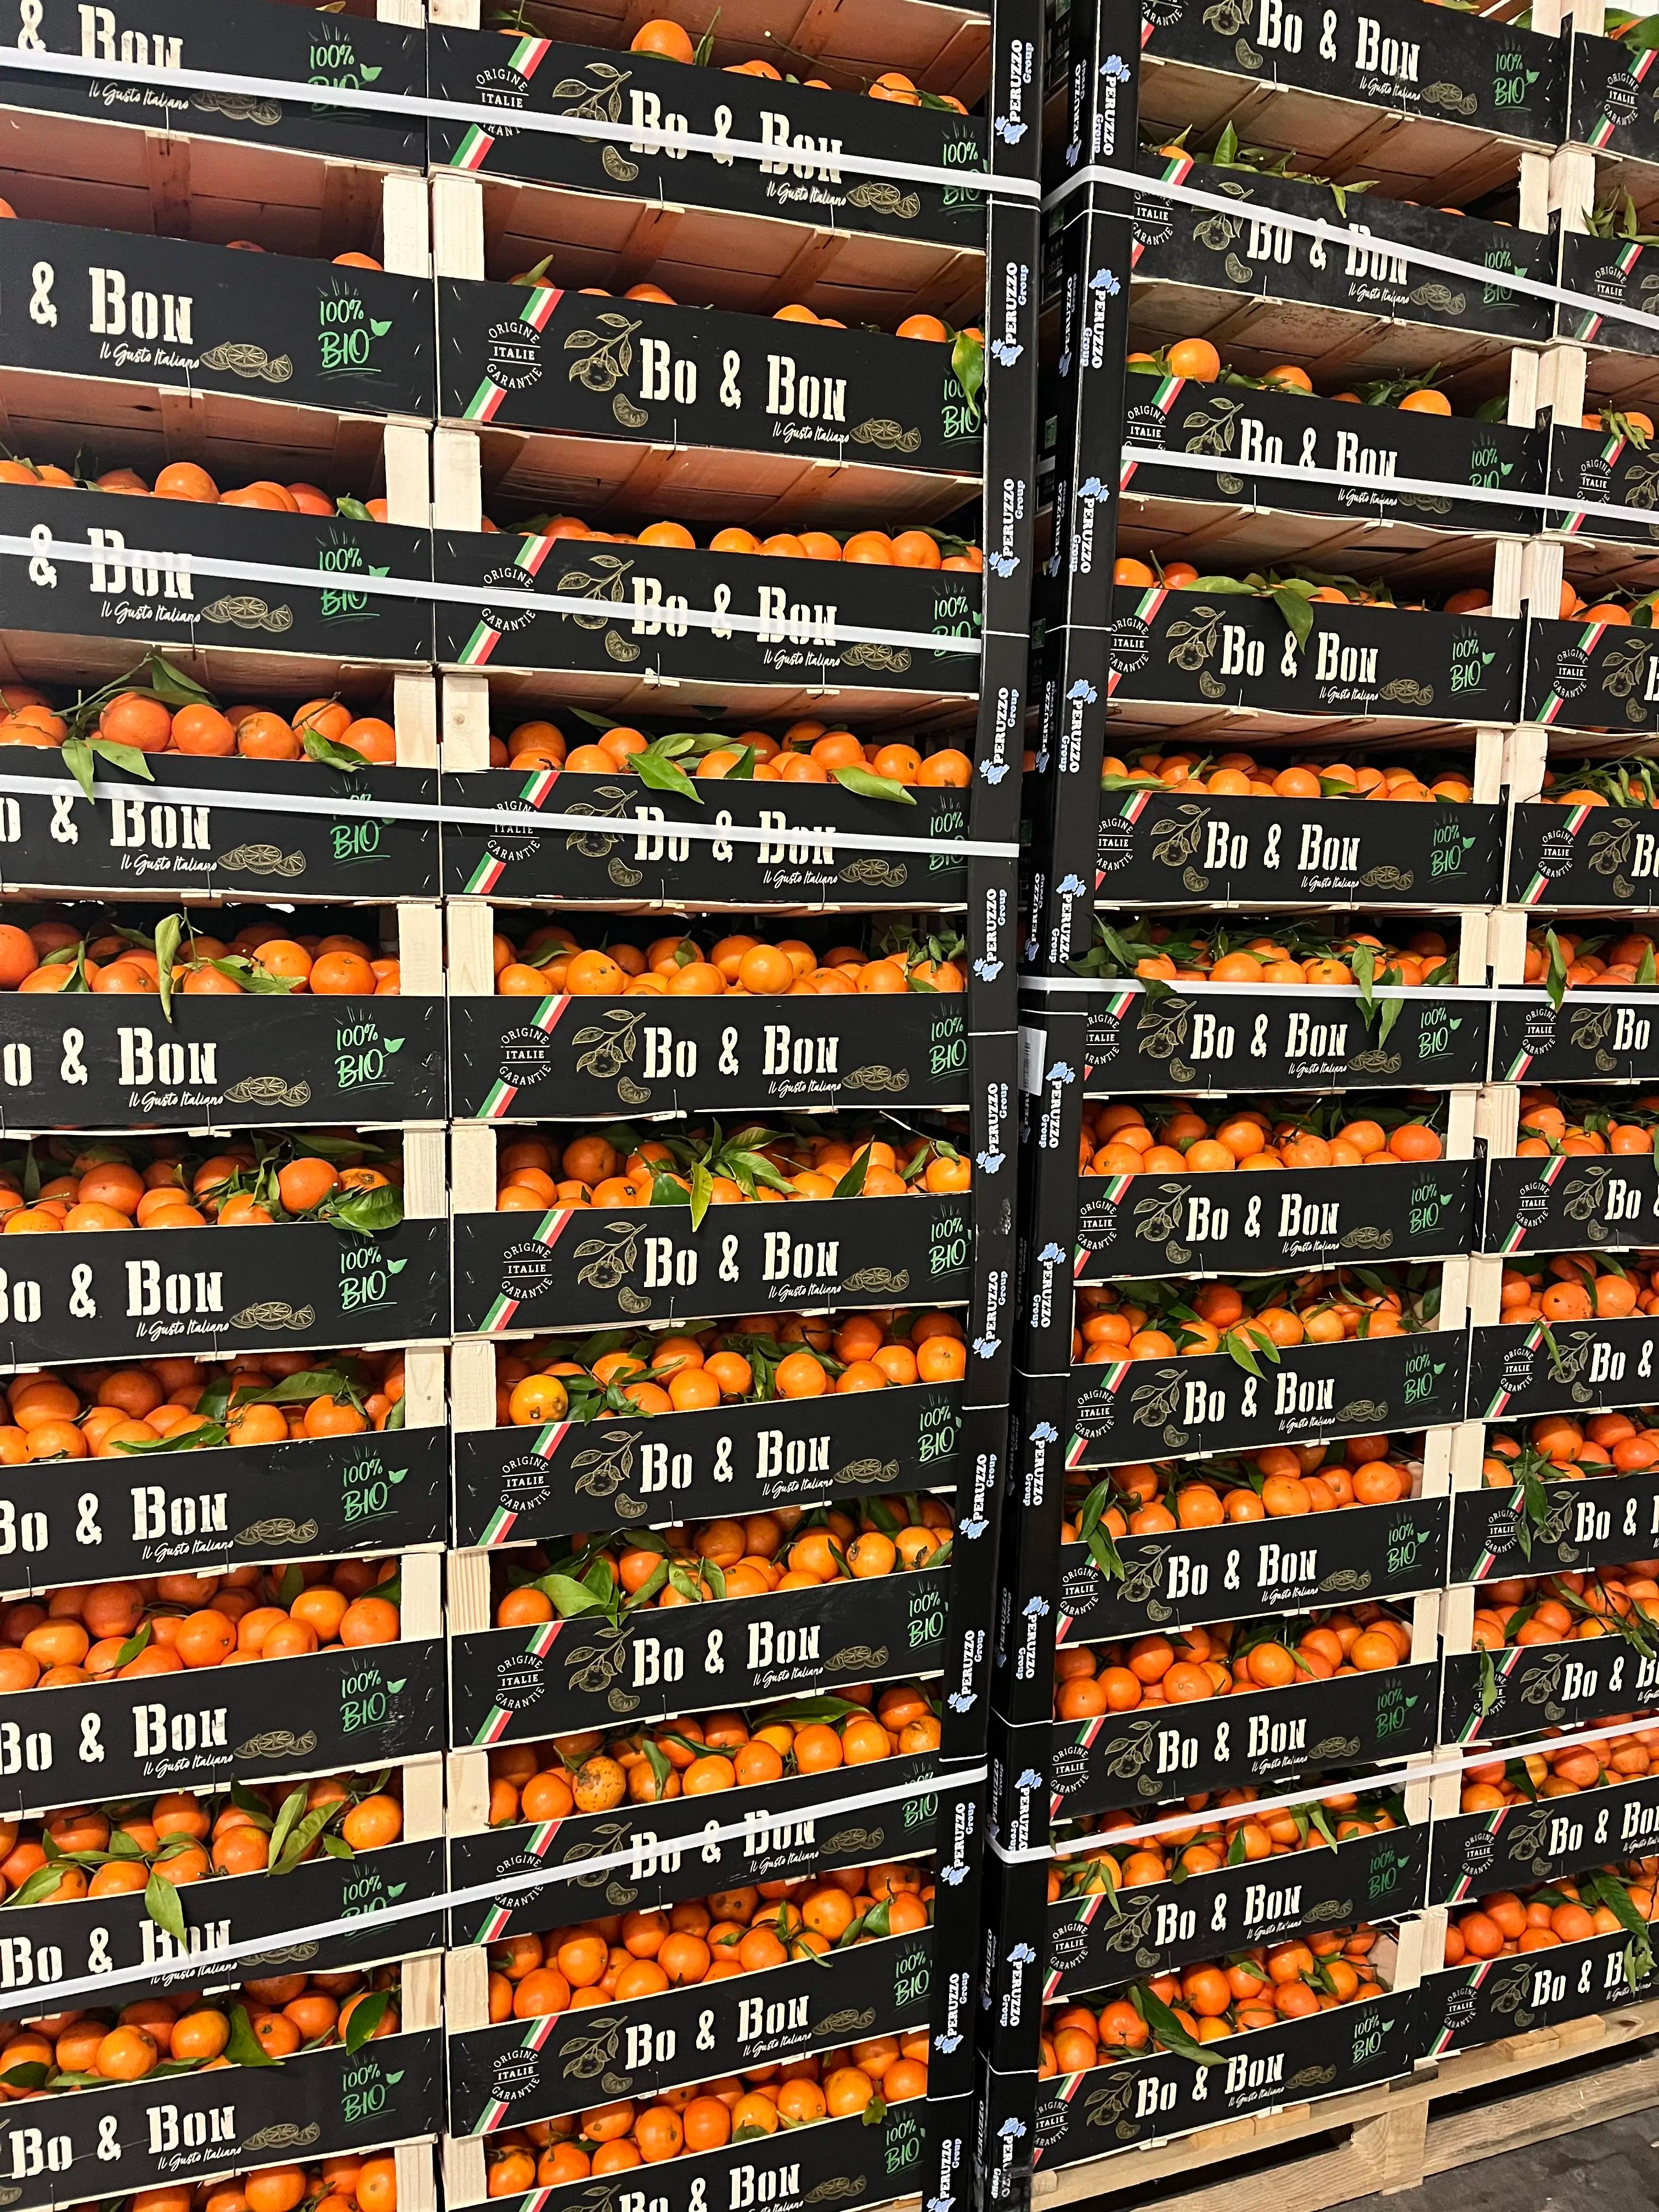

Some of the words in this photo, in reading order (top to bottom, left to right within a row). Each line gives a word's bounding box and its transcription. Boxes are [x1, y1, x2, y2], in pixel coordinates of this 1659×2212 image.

[1320, 9, 1336, 61] &
[1023, 43, 1034, 83] Group
[1497, 53, 1522, 72] 100%
[1010, 40, 1022, 122] PERUZZO
[1493, 74, 1527, 105] BIO
[1607, 73, 1639, 91] ORIGINE
[1609, 89, 1636, 103] ITALIE
[1604, 101, 1638, 125] GARANTIE
[30, 262, 57, 327] &
[320, 299, 364, 325] 100%
[488, 322, 539, 346] ORIGINE
[1092, 290, 1105, 368] PERUZZO
[113, 343, 151, 366] Gusto
[154, 348, 199, 372] Italiano
[318, 329, 374, 371] BIO
[493, 346, 535, 361] ITALIE
[1083, 328, 1092, 367] Group
[487, 364, 542, 388] GARANTIE
[640, 336, 697, 404] Bo
[720, 350, 741, 409] &
[941, 404, 980, 437] BIO
[783, 422, 812, 443] Gusto
[814, 426, 849, 447] Italiano
[1015, 481, 1025, 519] Group
[1003, 479, 1014, 557] PERUZZO
[1221, 625, 1264, 676] Bo
[1453, 639, 1479, 661] 100%
[1450, 661, 1483, 692] BIO
[1328, 686, 1350, 703] Gusto
[1351, 688, 1378, 704] Italiano
[1070, 699, 1083, 772] PERUZZO
[1059, 736, 1070, 772] Group
[1204, 822, 1248, 868] Bo
[1264, 824, 1281, 870] &
[1434, 825, 1459, 846] 100%
[1543, 830, 1573, 844] ORIGINE
[1431, 845, 1465, 876] BIO
[1543, 845, 1570, 857] ITALIE
[1538, 857, 1572, 877] GARANTIE
[1309, 876, 1331, 892] Gusto
[1332, 876, 1359, 891] Italiano
[337, 1024, 378, 1050] 100%
[501, 1028, 550, 1048] ORIGINE
[932, 1018, 963, 1041] 100%
[61, 1028, 87, 1085] &
[506, 1048, 545, 1060] ITALIE
[644, 1028, 696, 1077] Bo
[719, 1027, 738, 1075] &
[929, 1040, 968, 1074] BIO
[335, 1049, 386, 1090] BIO
[500, 1061, 551, 1085] GARANTIE
[142, 1091, 178, 1112] Gusto
[180, 1091, 223, 1109] Italiano
[778, 1080, 806, 1098] Gusto
[808, 1080, 841, 1092] Italiano
[1000, 1084, 1008, 1118] Group
[988, 1084, 998, 1154] PERUZZO
[1412, 1184, 1437, 1205] 100%
[1520, 1182, 1549, 1198] ORIGINE
[1521, 1197, 1547, 1209] ITALIE
[1605, 1180, 1641, 1220] Bo
[1080, 1201, 1117, 1218] ORIGINE
[1083, 1217, 1113, 1229] ITALIE
[1186, 1198, 1228, 1241] Bo
[1245, 1195, 1261, 1238] &
[1409, 1204, 1442, 1233] BIO
[1517, 1207, 1548, 1227] GARANTIE
[1078, 1228, 1116, 1249] GARANTIE
[1290, 1241, 1312, 1257] Gusto
[1313, 1240, 1339, 1254] Italiano
[341, 1244, 381, 1272] 100%
[70, 1263, 95, 1318] &
[338, 1271, 388, 1312] BIO
[149, 1321, 184, 1341] Gusto
[187, 1319, 229, 1336] Italiano
[921, 1402, 951, 1431] 100%
[918, 1427, 957, 1463] BIO
[502, 1457, 549, 1477] ORIGINE
[640, 1443, 692, 1493] Bo
[714, 1437, 733, 1482] &
[986, 1454, 997, 1487] Group
[506, 1475, 545, 1487] ITALIE
[772, 1481, 799, 1499] Gusto
[800, 1478, 833, 1491] Italiano
[973, 1454, 986, 1521] PERUZZO
[500, 1486, 550, 1510] GARANTIE
[342, 1670, 381, 1698] 100%
[340, 1692, 388, 1732] BIO
[79, 1713, 104, 1762] &
[155, 1757, 190, 1778] Gusto
[192, 1754, 233, 1769] Italiano
[966, 1803, 975, 1835] Group
[954, 1803, 965, 1868] PERUZZO
[1370, 1850, 1394, 1874] 100%
[1368, 1867, 1396, 1898] BIO
[1052, 1923, 1087, 1943] ORIGINE
[1155, 1904, 1195, 1946] Bo
[1211, 1893, 1227, 1931] &
[1051, 1945, 1088, 1969] GARANTIE
[1055, 1938, 1085, 1951] ITALIE
[896, 1951, 926, 1978] 100%
[894, 1971, 929, 2005] BIO
[1010, 1961, 1022, 2026] PERUZZO
[1531, 1970, 1566, 2007] Bo
[1578, 1960, 1592, 1993] &
[1000, 1994, 1010, 2027] Group
[1447, 1988, 1476, 2007] ORIGINE
[1448, 2002, 1474, 2016] ITALIE
[1444, 2008, 1476, 2028] GARANTIE
[625, 2024, 675, 2069] Bo
[696, 2010, 714, 2050] &
[753, 2039, 778, 2057] Gusto
[780, 2033, 811, 2047] Italiano
[493, 2050, 538, 2072] ORIGINE
[499, 2066, 533, 2080] ITALIE
[343, 2064, 380, 2091] 100%
[492, 2074, 540, 2100] GARANTIE
[342, 2085, 388, 2121] BIO
[6, 2128, 75, 2179] Bo
[97, 2116, 121, 2160] &
[169, 2152, 201, 2171] Gusto
[203, 2147, 241, 2162] Italiano
